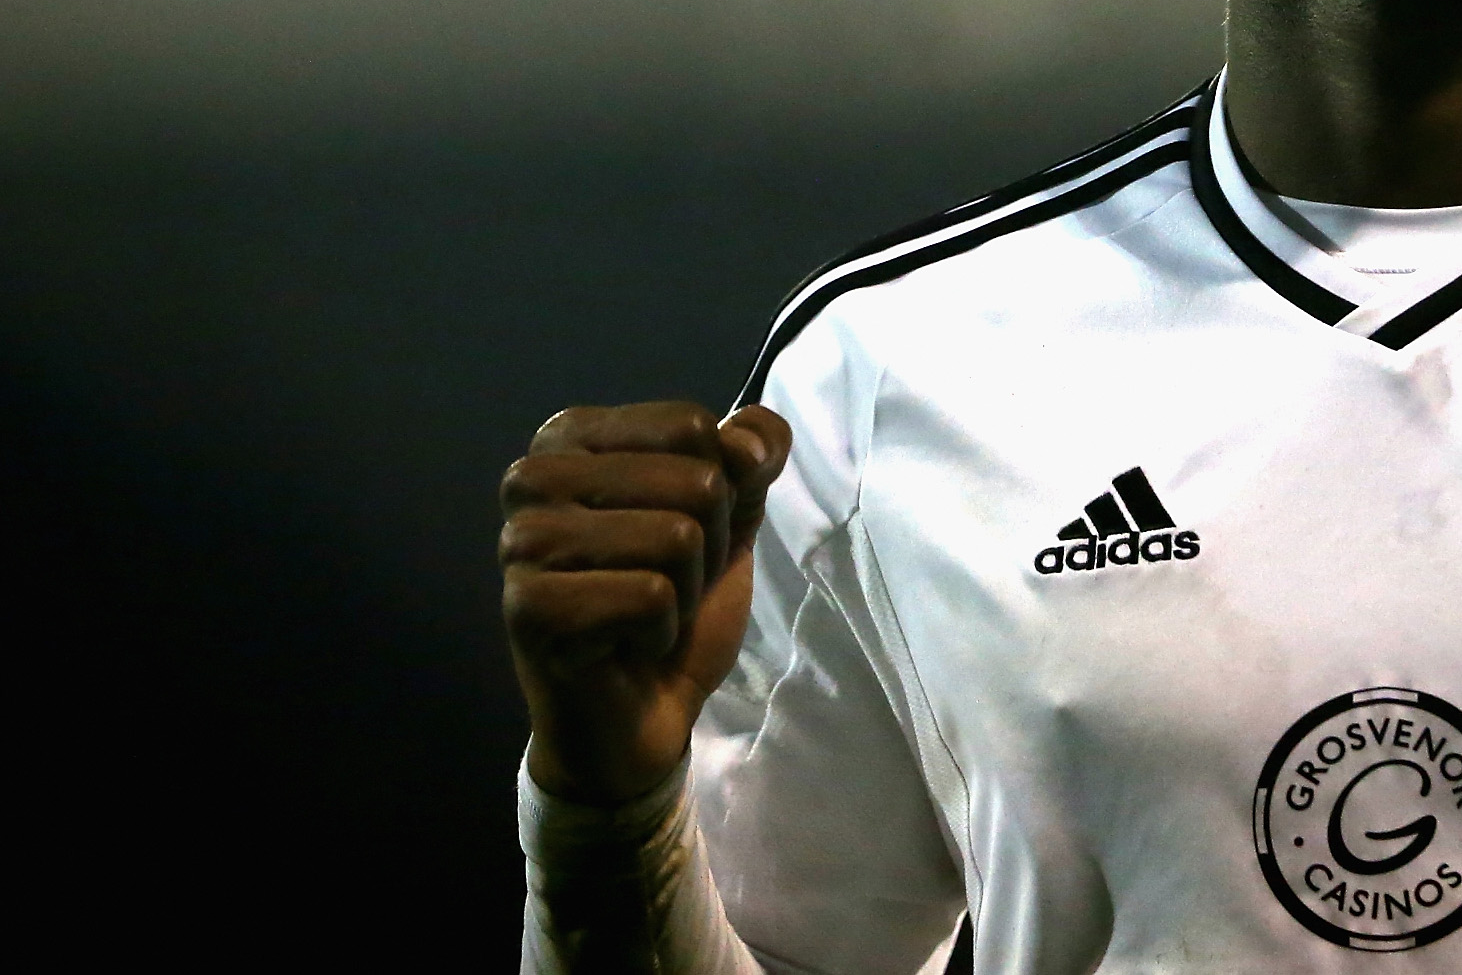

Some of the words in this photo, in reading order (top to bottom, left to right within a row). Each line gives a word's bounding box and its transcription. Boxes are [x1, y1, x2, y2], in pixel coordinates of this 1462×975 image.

[1034, 531, 1200, 574] adidas
[1327, 759, 1438, 875] G
[1304, 863, 1462, 920] CASINOS
